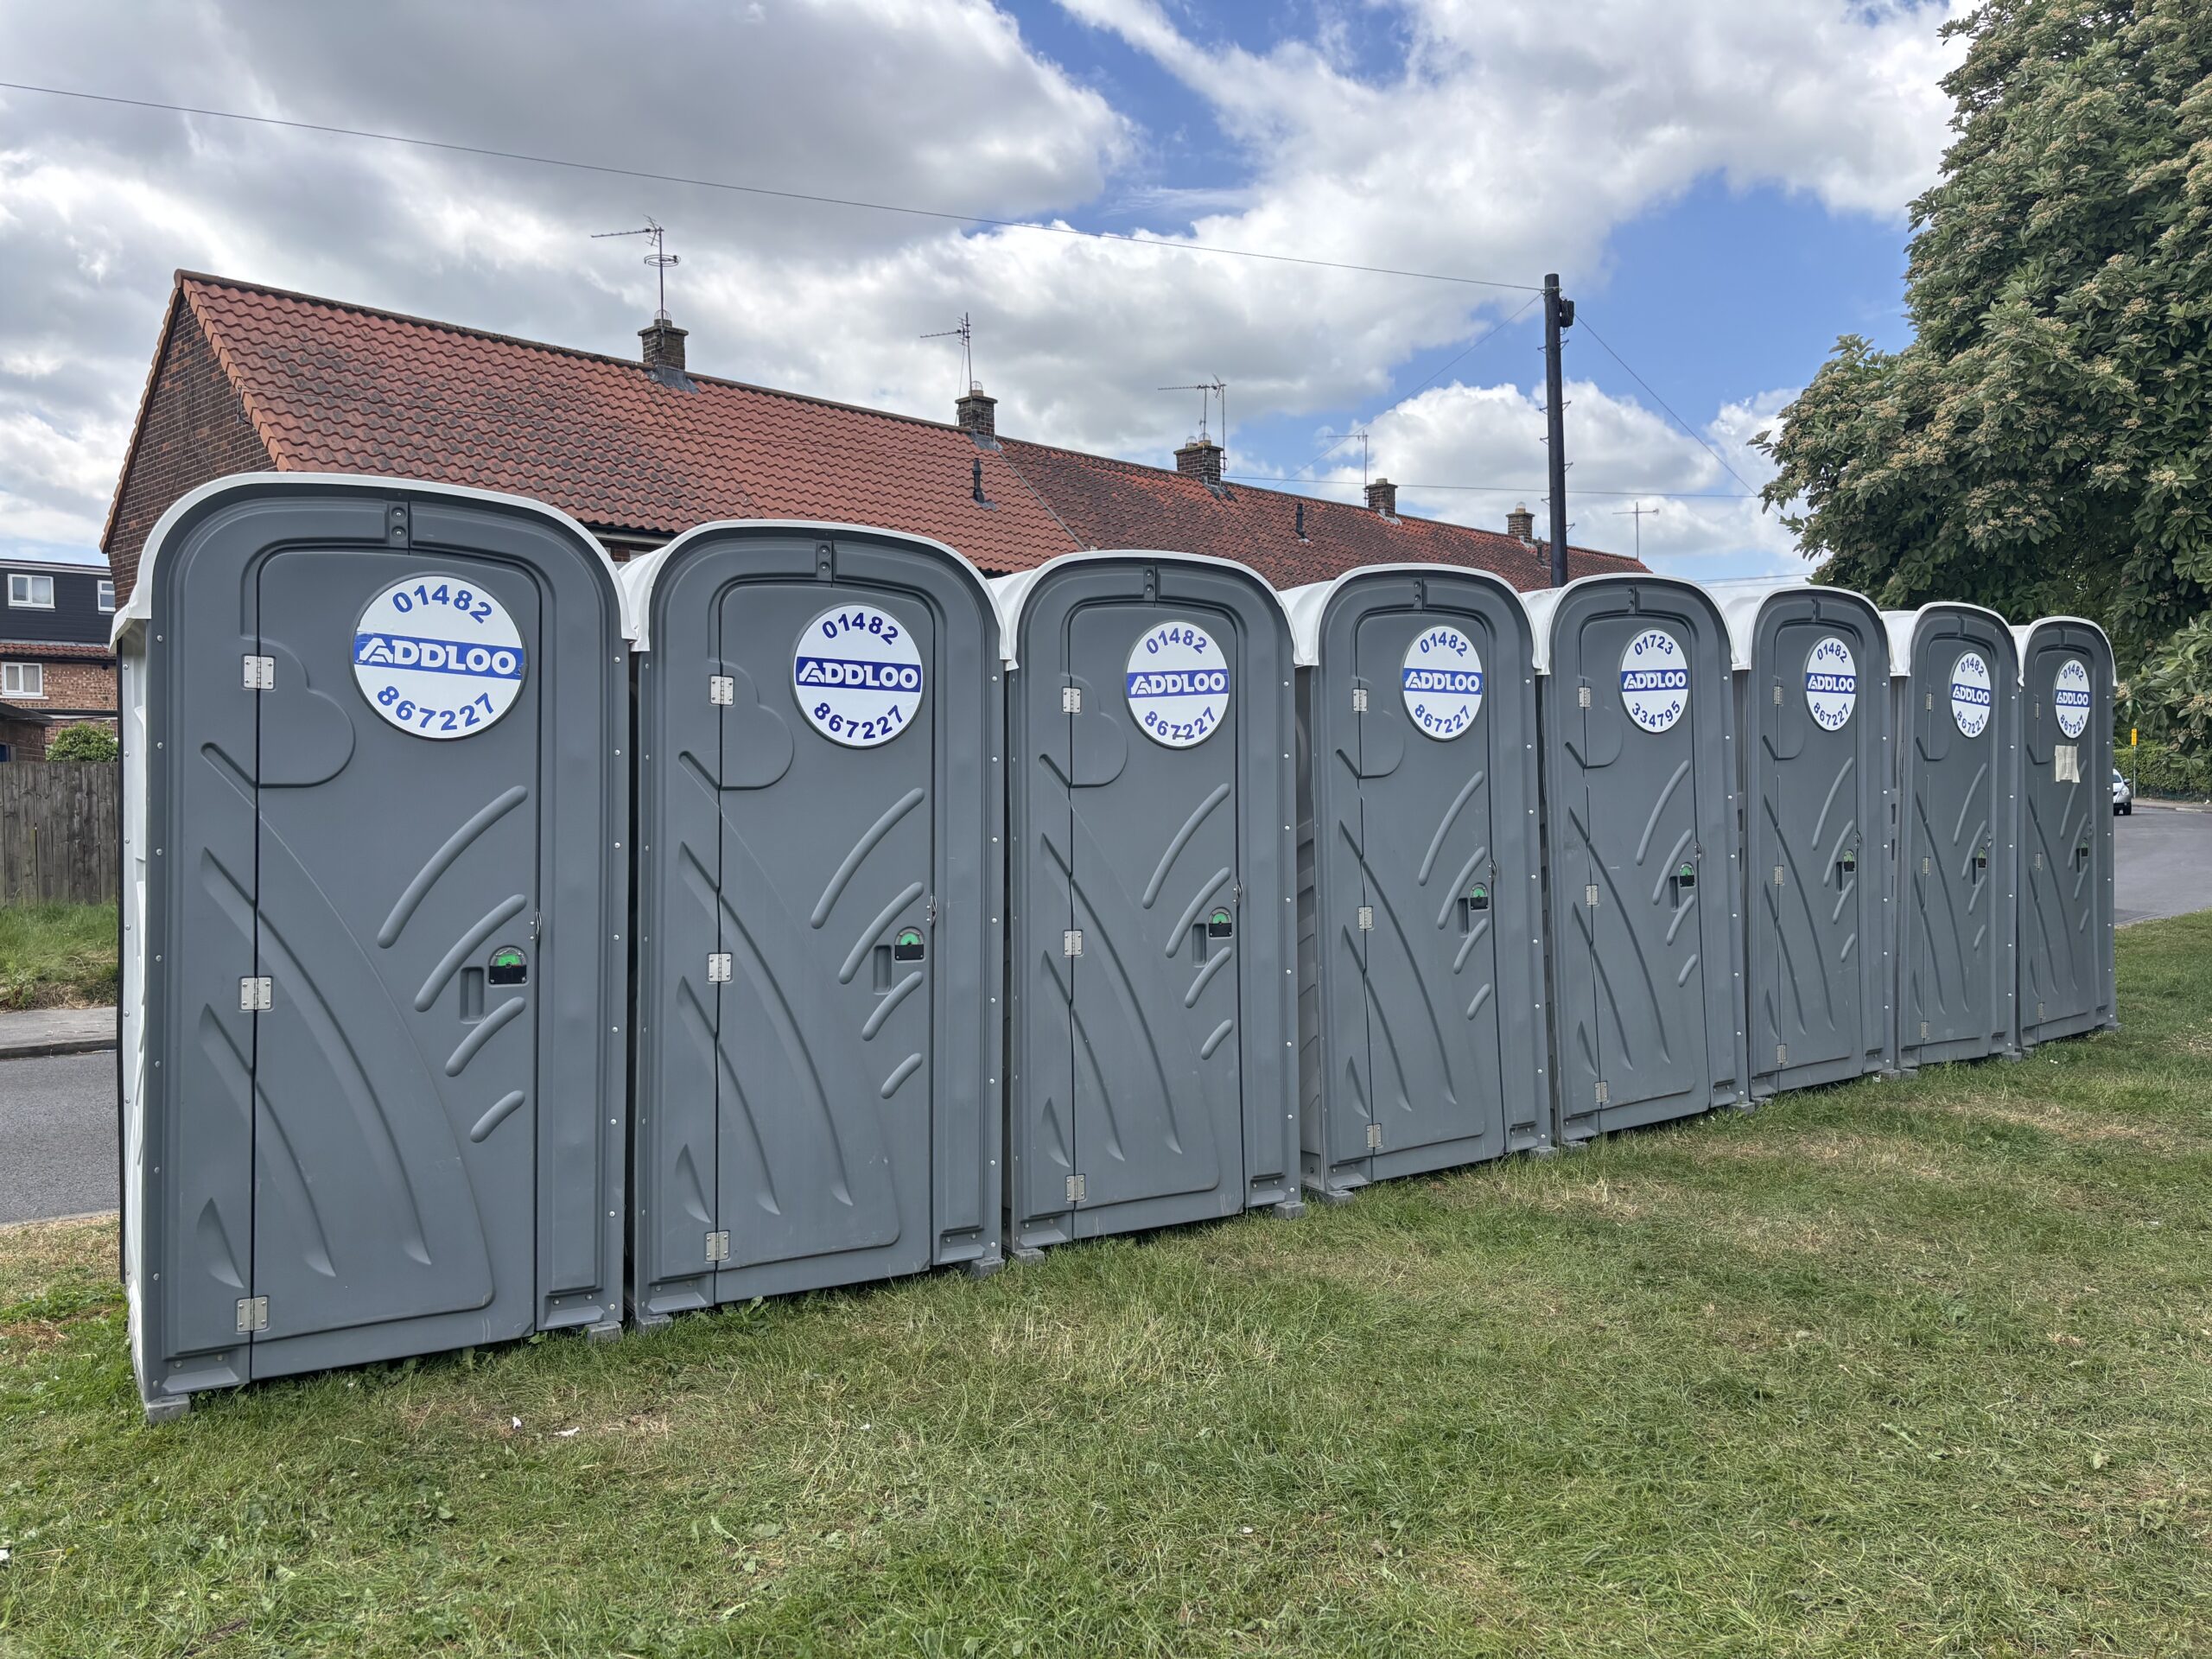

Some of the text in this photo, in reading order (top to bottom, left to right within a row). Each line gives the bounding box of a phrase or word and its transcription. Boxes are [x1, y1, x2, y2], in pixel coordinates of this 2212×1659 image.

[392, 584, 493, 623] 01482
[822, 613, 899, 645] 01482
[1146, 628, 1207, 654] 01482
[359, 638, 516, 675] ADDLOO
[1421, 632, 1468, 657] 01482
[1634, 635, 1674, 655] 01723
[1817, 642, 1847, 663] 01482
[799, 661, 918, 687] ADDLOO
[1961, 658, 1985, 677] 01482
[2063, 664, 2084, 681] 01482
[1131, 673, 1225, 695] ADDLOO
[1405, 672, 1479, 691] ADDLOO
[1624, 672, 1686, 689] ADDLOO
[1808, 676, 1855, 691] ADDLOO
[1953, 686, 1989, 704] ADDLOO
[2056, 692, 2088, 705] ADDLOO
[377, 685, 493, 731] 867227
[1414, 704, 1470, 733] 867227
[1632, 700, 1681, 727] 334795
[1814, 702, 1848, 726] 867227
[814, 702, 902, 740] 867227
[1145, 706, 1217, 740] 867227
[1956, 710, 1985, 734] 867227
[2060, 715, 2084, 734] 867227
